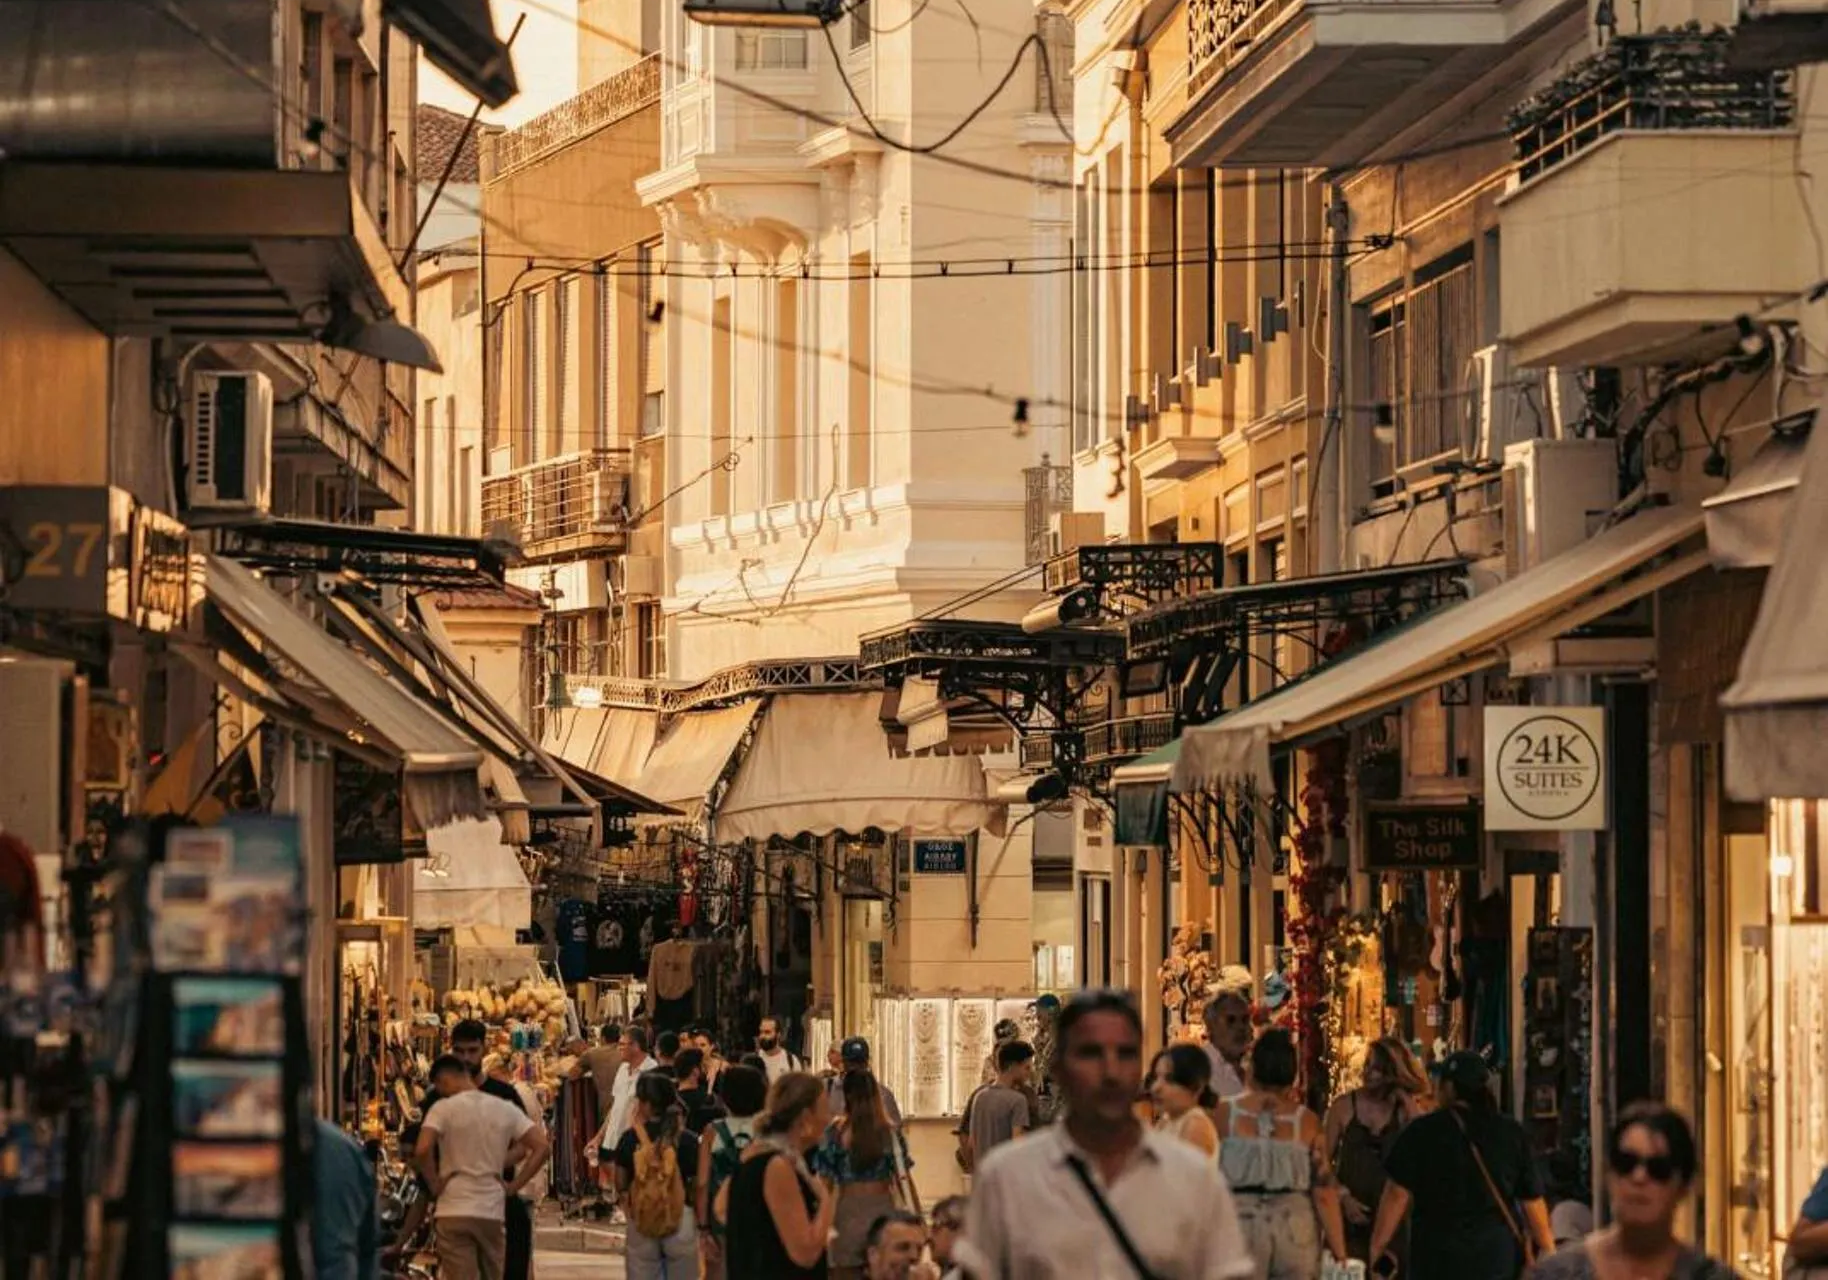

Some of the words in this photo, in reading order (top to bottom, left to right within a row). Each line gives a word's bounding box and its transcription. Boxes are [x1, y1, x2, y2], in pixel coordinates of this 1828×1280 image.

[25, 521, 103, 577] 27
[1515, 734, 1581, 764] 24K
[1514, 771, 1583, 789] SUITES
[1376, 818, 1419, 839] The
[1425, 816, 1468, 837] Silk
[1394, 838, 1452, 861] Shop
